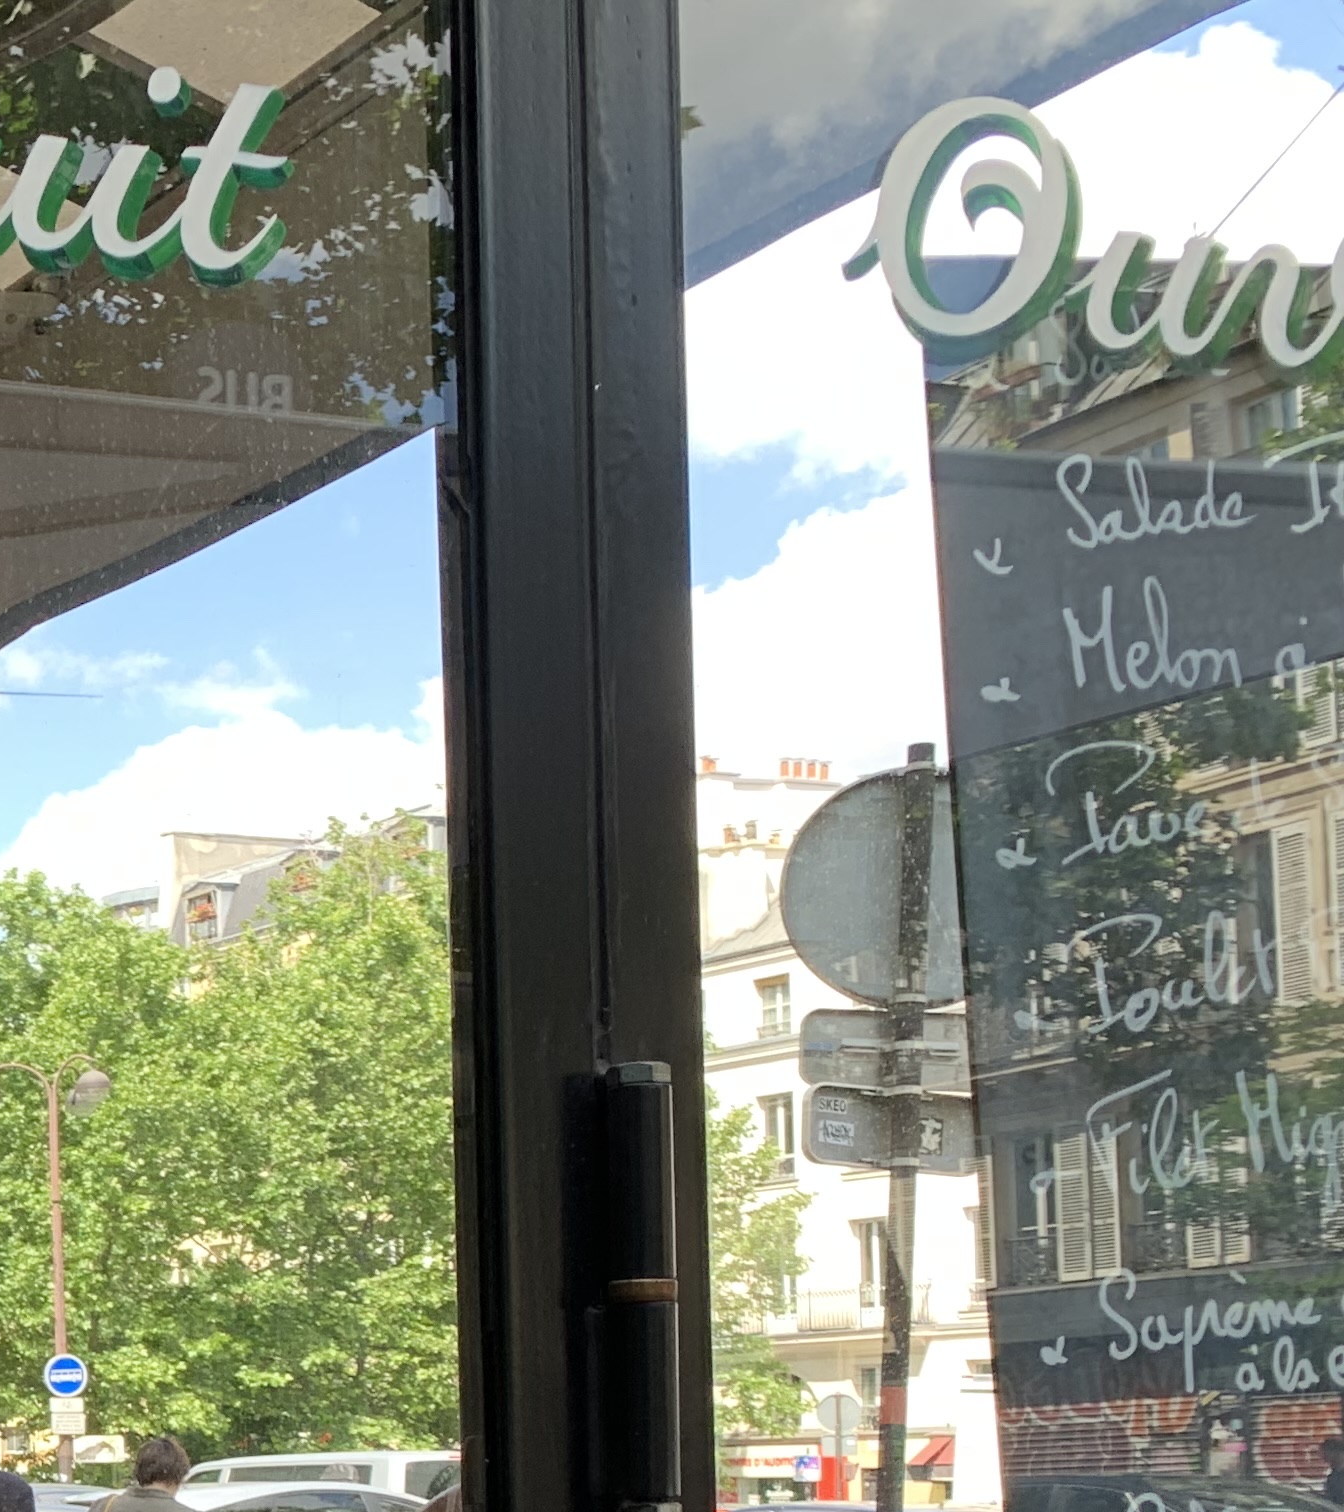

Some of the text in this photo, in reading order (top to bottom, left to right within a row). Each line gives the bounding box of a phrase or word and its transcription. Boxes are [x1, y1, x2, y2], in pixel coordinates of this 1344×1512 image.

[1056, 453, 1258, 549] Salade
[1063, 575, 1243, 693] Melon
[1085, 1068, 1344, 1210] Filet Mig
